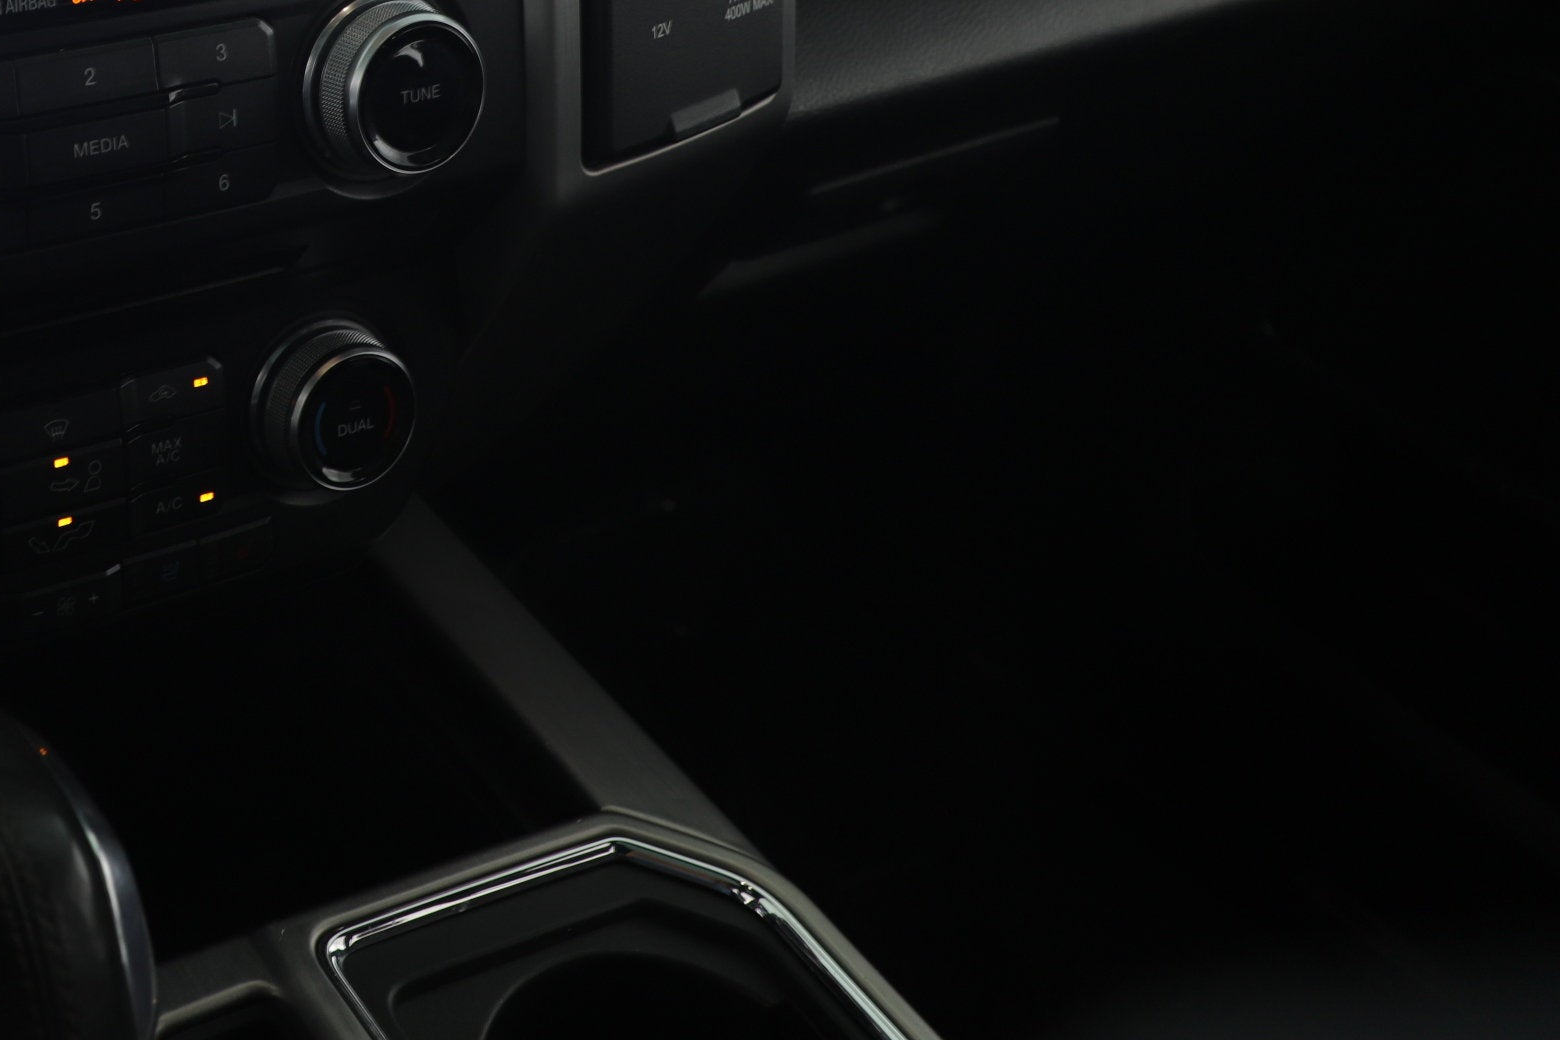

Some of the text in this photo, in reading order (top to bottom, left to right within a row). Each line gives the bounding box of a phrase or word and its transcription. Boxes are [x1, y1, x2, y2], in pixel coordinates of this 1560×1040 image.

[724, 2, 752, 21] 400W
[651, 20, 673, 39] 12V
[215, 42, 227, 61] 3
[83, 68, 97, 86] 2
[400, 83, 441, 105] TUNE
[73, 134, 129, 159] MEDIA
[218, 173, 231, 192] 6
[90, 201, 102, 220] 5
[336, 416, 375, 438] DUAL
[150, 436, 182, 455] MAX
[153, 448, 182, 466] A/C
[154, 496, 184, 514] A/C
